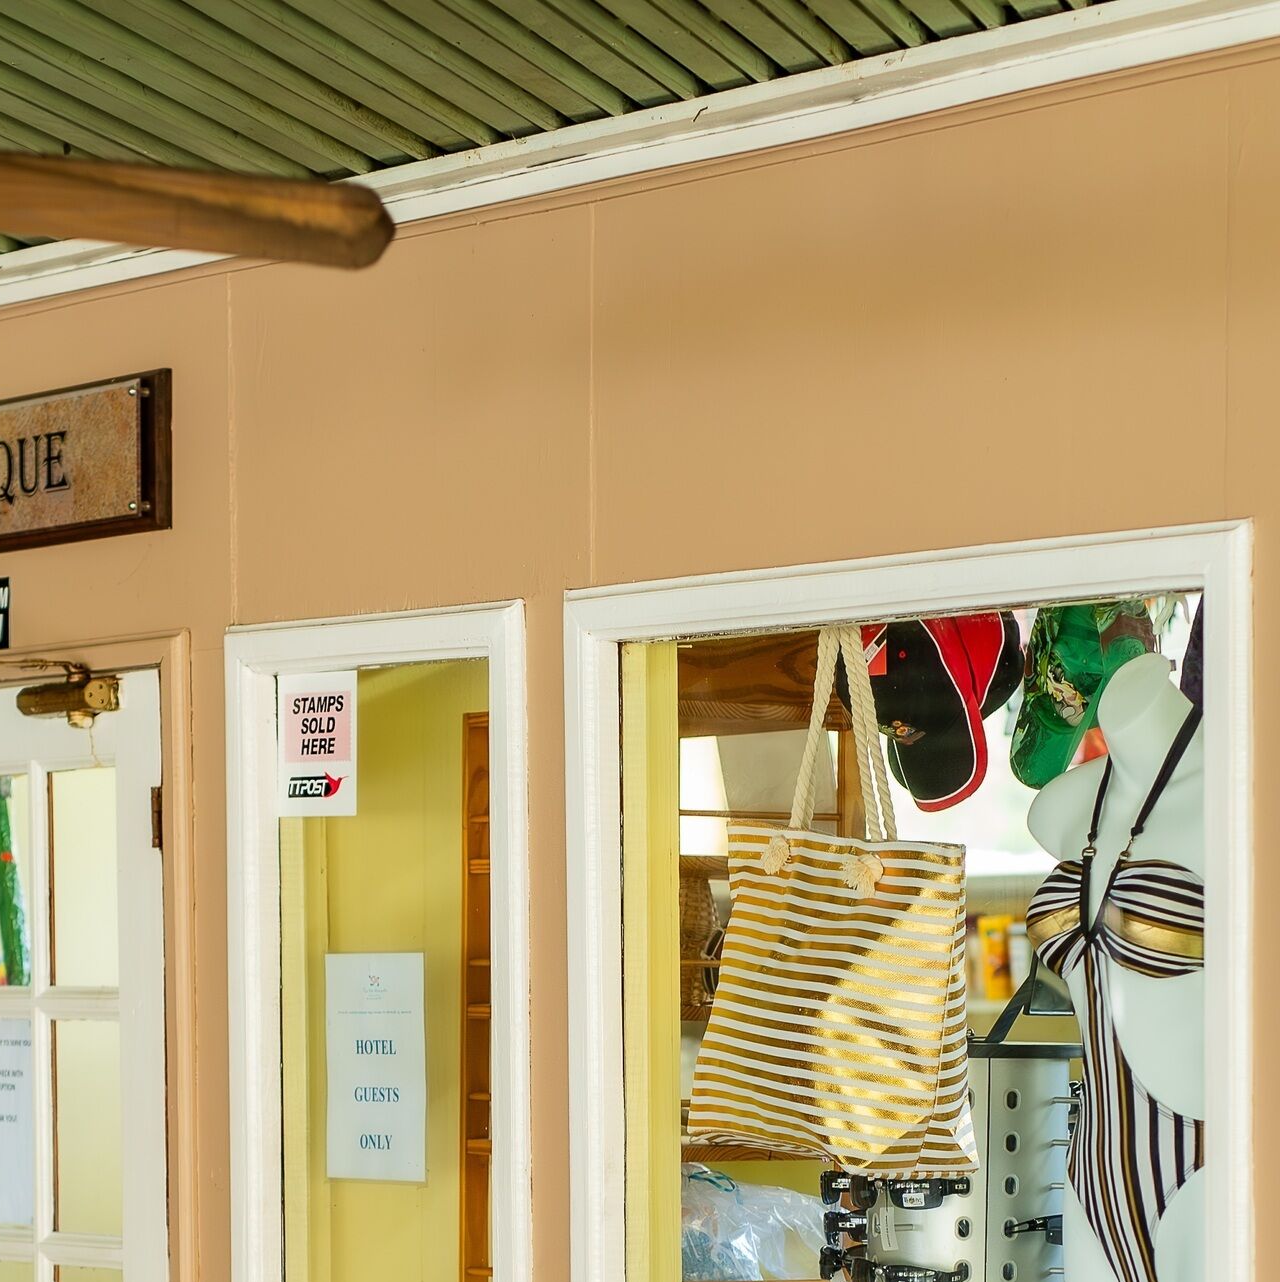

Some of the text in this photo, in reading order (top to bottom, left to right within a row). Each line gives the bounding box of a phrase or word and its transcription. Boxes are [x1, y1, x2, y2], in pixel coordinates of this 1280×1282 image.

[292, 695, 344, 715] STAMPS
[301, 717, 336, 735] SOLD
[301, 737, 336, 756] HERE
[289, 778, 329, 796] TTPOST
[356, 1040, 397, 1055] HOTEL
[354, 1087, 400, 1103] GUESTS
[360, 1134, 393, 1150] ONLY
